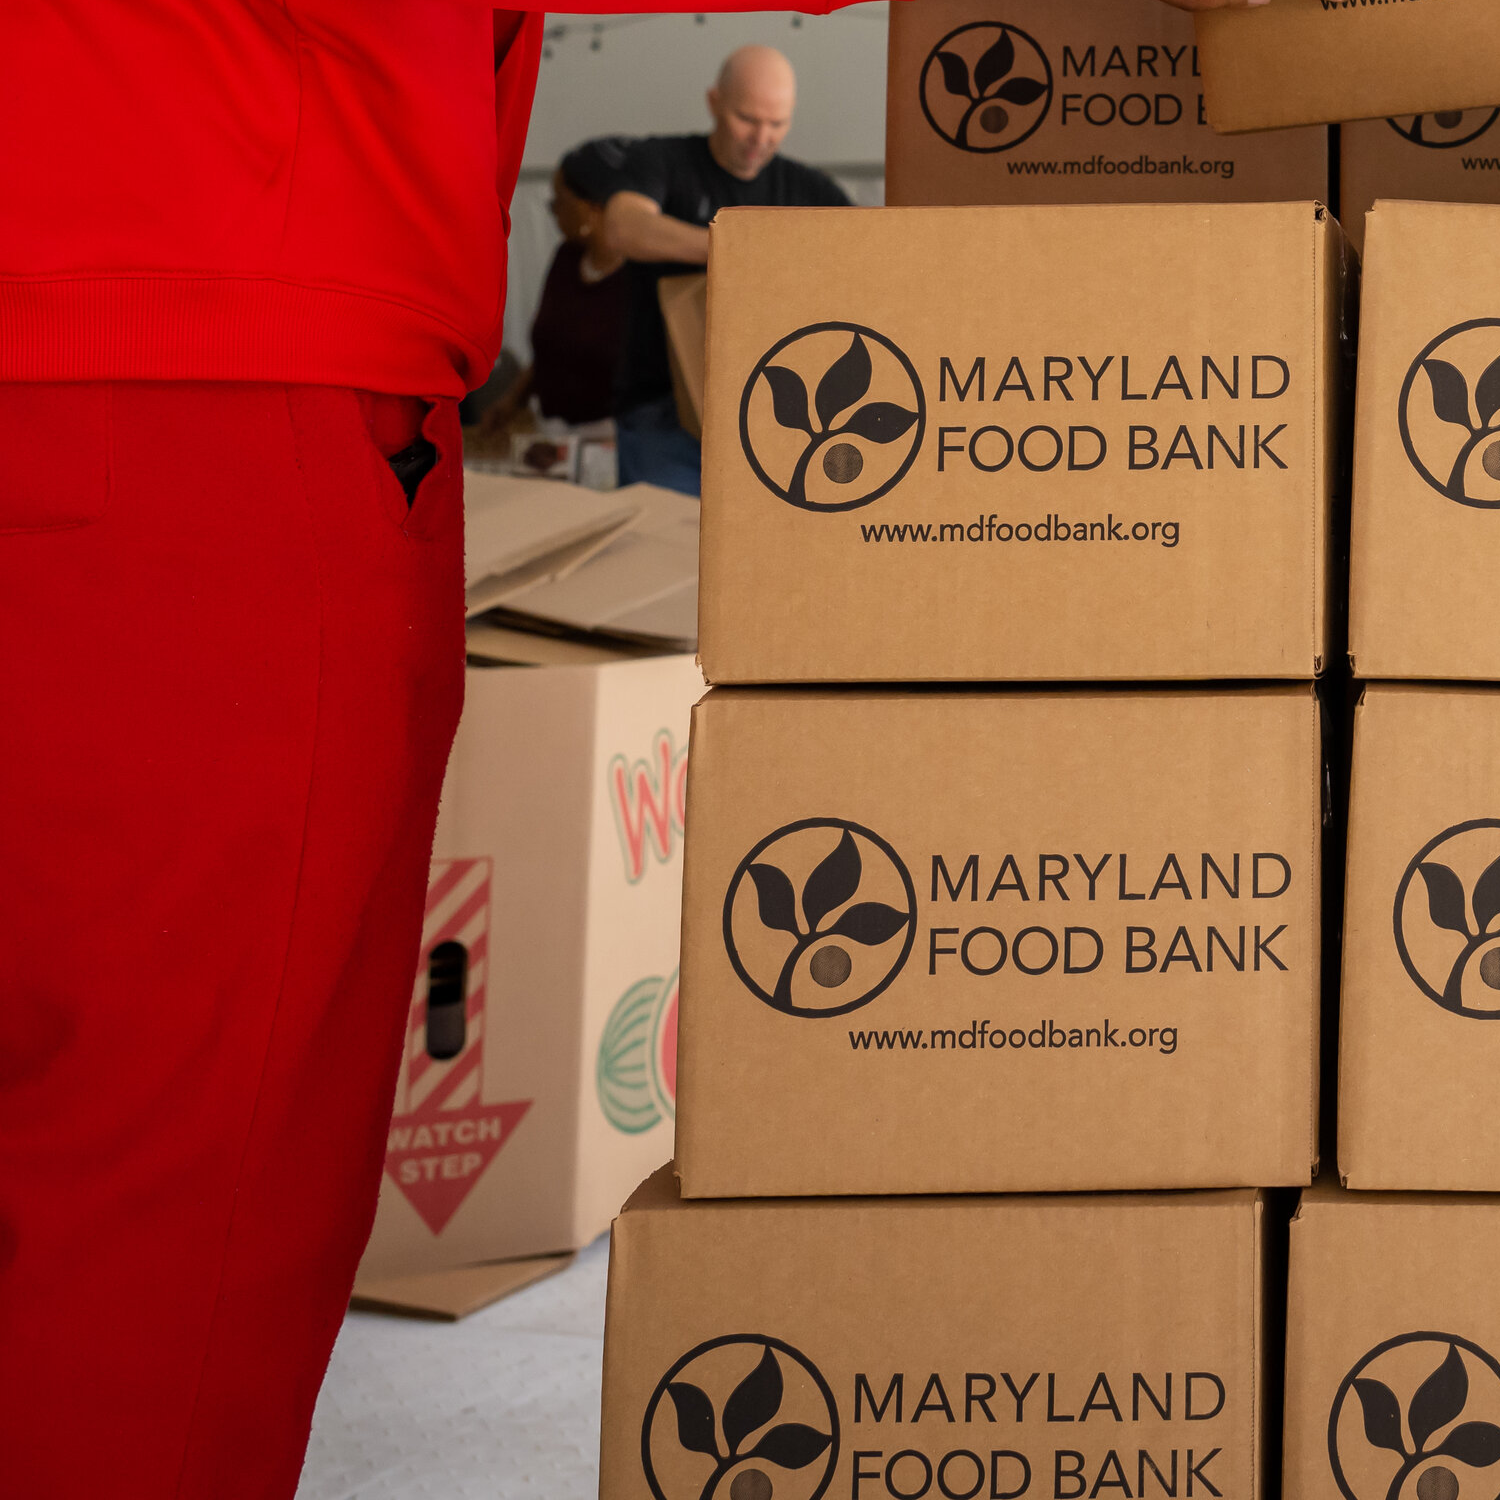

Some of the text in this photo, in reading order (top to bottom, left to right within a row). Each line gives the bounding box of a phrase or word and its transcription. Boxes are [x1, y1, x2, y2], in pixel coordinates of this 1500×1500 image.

[1060, 40, 1200, 80] MARYL
[1062, 93, 1182, 126] FOOD
[1007, 155, 1234, 179] www.mdfoodbank.org
[940, 355, 1290, 402] MARYLAND
[938, 424, 1288, 472] FOOD BANK
[861, 514, 1179, 547] www.mdfoodbank.org
[931, 853, 1291, 901] MARYLAND
[929, 925, 1288, 975] FOOD BANK
[849, 1019, 1177, 1054] www.mdfoodbank.org
[400, 1152, 482, 1185] STEP
[854, 1373, 1225, 1423] MARYLAND
[852, 1448, 1223, 1500] FOOD BANK
